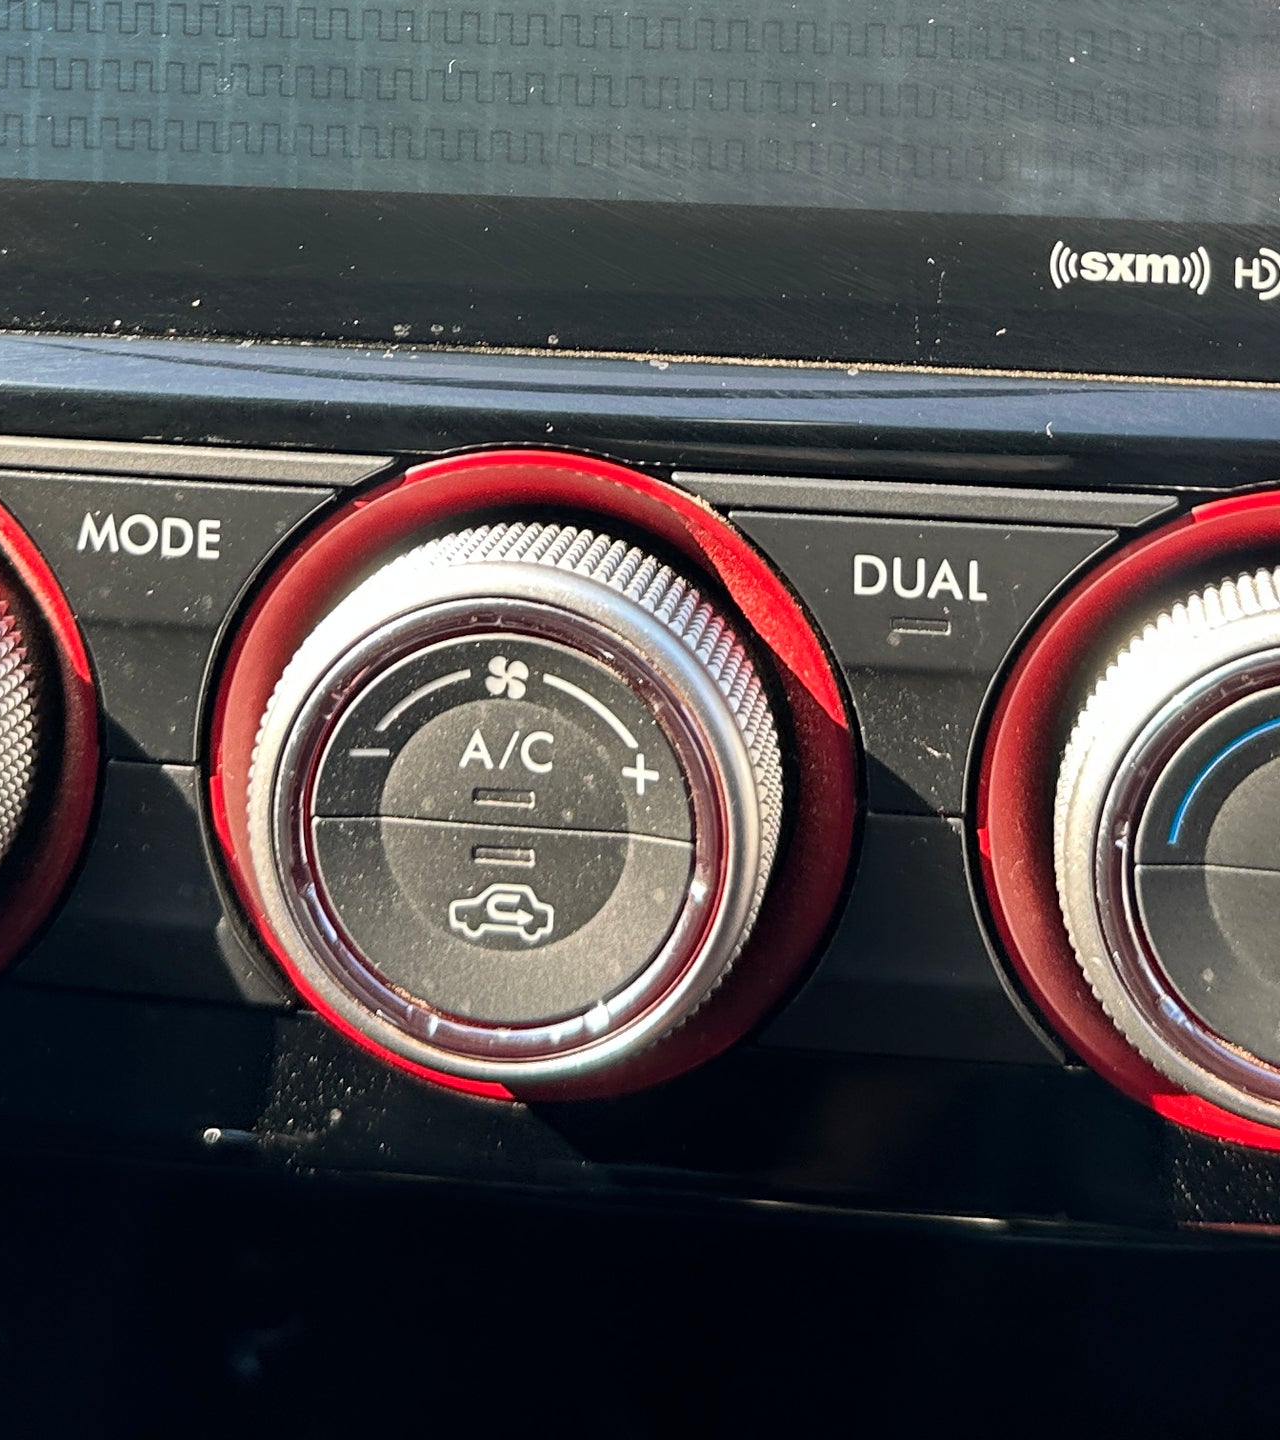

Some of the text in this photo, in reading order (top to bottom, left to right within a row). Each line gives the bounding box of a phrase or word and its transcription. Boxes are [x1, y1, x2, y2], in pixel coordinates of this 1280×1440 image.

[77, 513, 221, 560] MODE
[852, 555, 989, 602] DUAL
[458, 730, 555, 774] A/C
